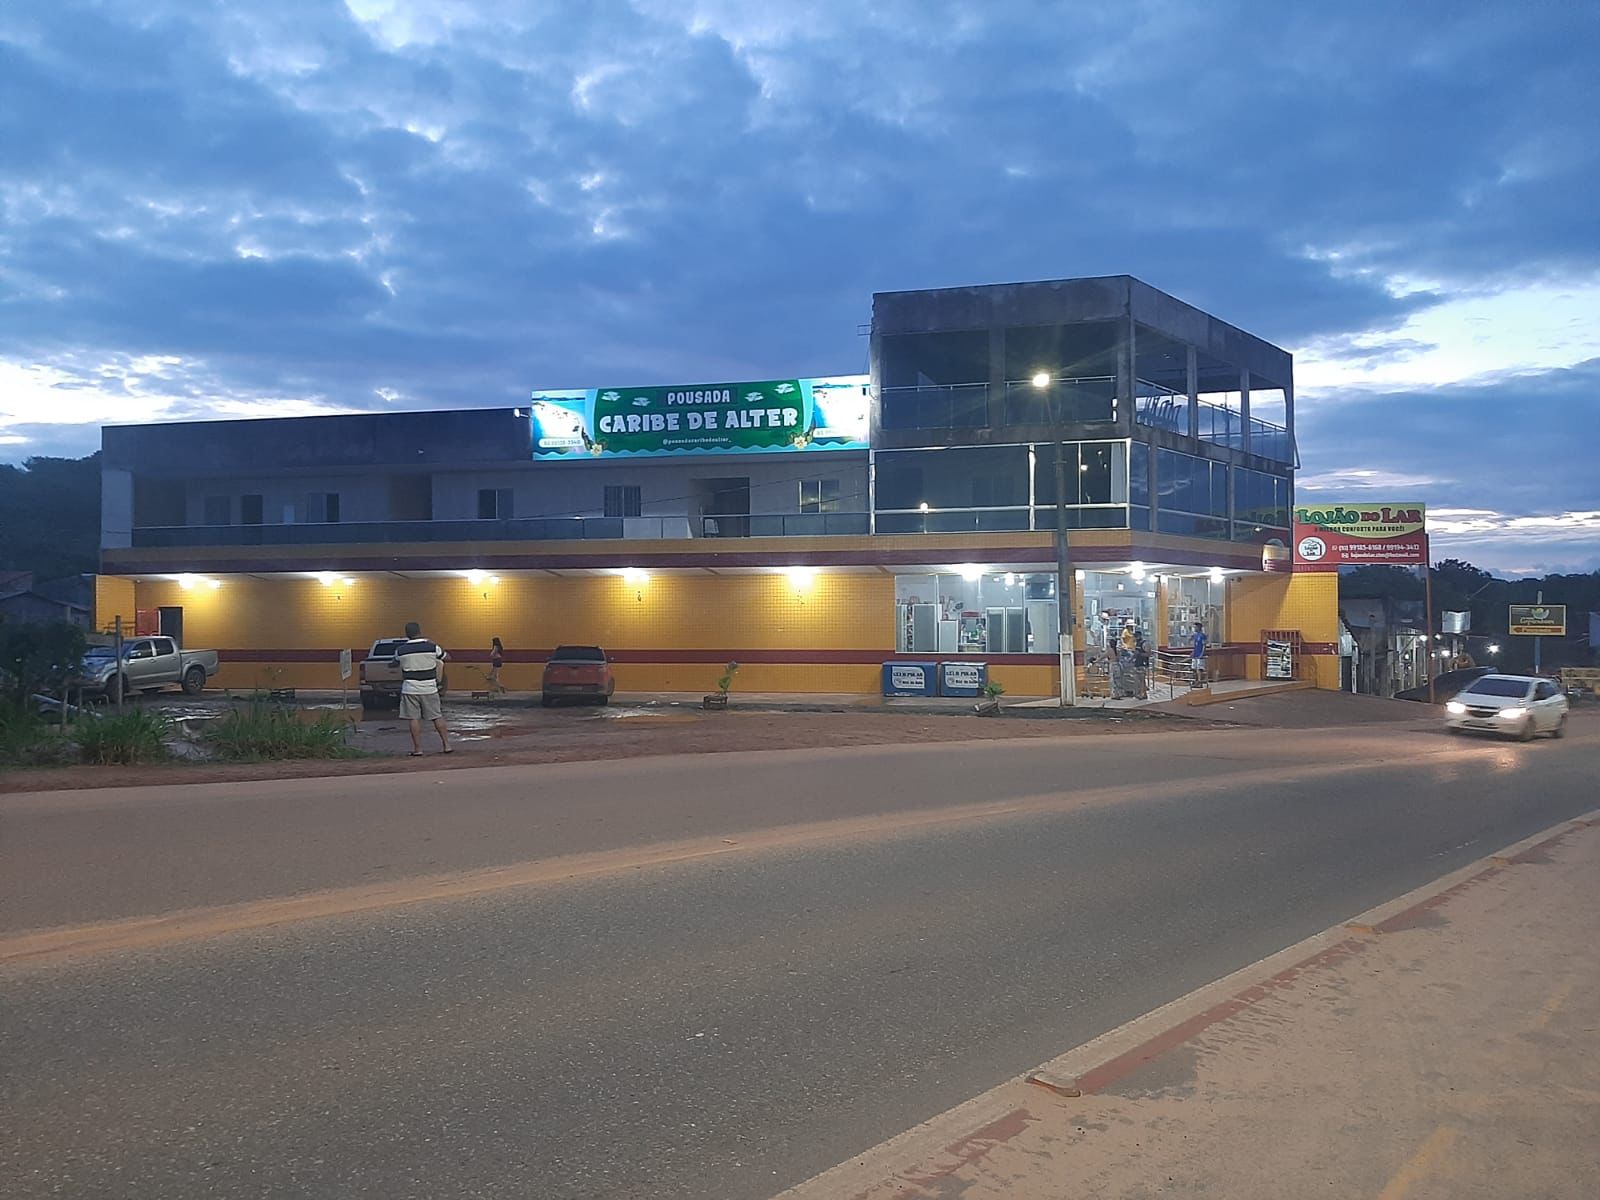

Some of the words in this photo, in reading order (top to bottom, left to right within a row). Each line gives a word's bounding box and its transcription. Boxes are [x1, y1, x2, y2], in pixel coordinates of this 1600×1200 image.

[667, 389, 730, 405] POUSADA
[599, 413, 680, 433] CARIBE
[687, 411, 717, 430] DE
[725, 407, 798, 429] ALTER
[1360, 511, 1380, 521] DO
[1381, 507, 1422, 523] LAR
